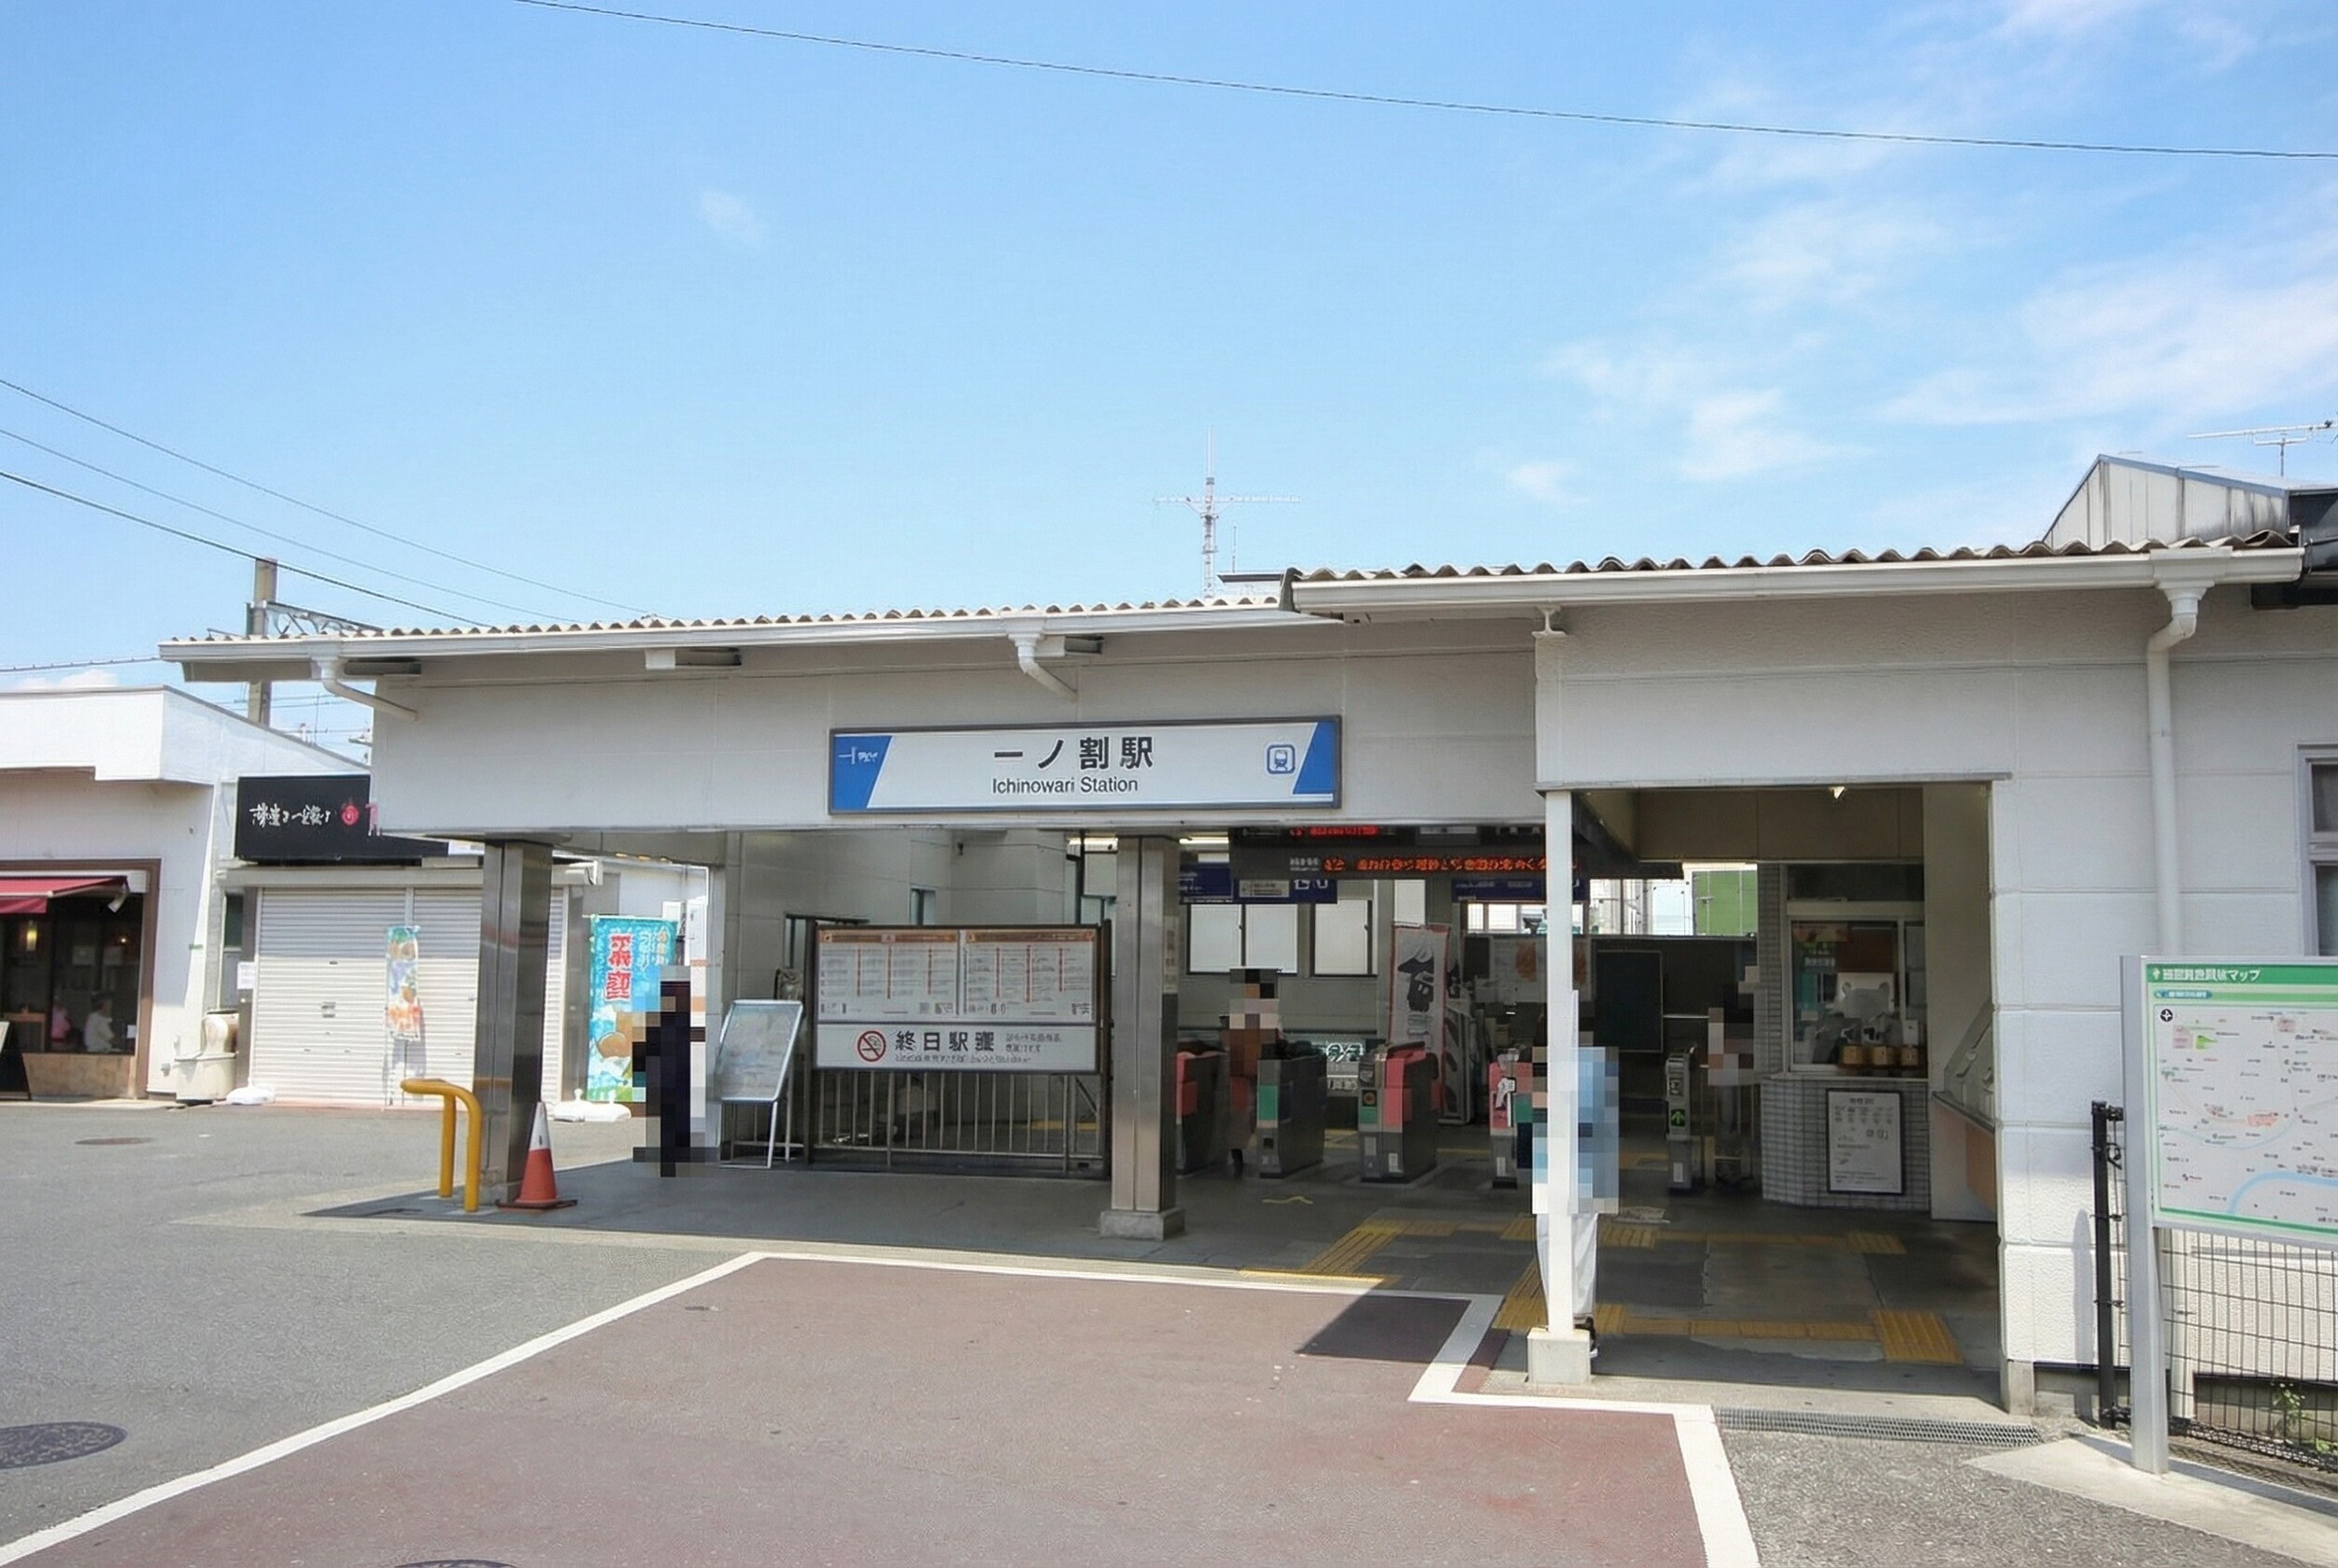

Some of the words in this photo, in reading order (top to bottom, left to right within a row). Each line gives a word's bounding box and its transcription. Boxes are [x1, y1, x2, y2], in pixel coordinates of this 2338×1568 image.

[994, 736, 1154, 770] 一ノ割駅
[992, 777, 1075, 795] Ichinowari
[1080, 776, 1139, 794] Station
